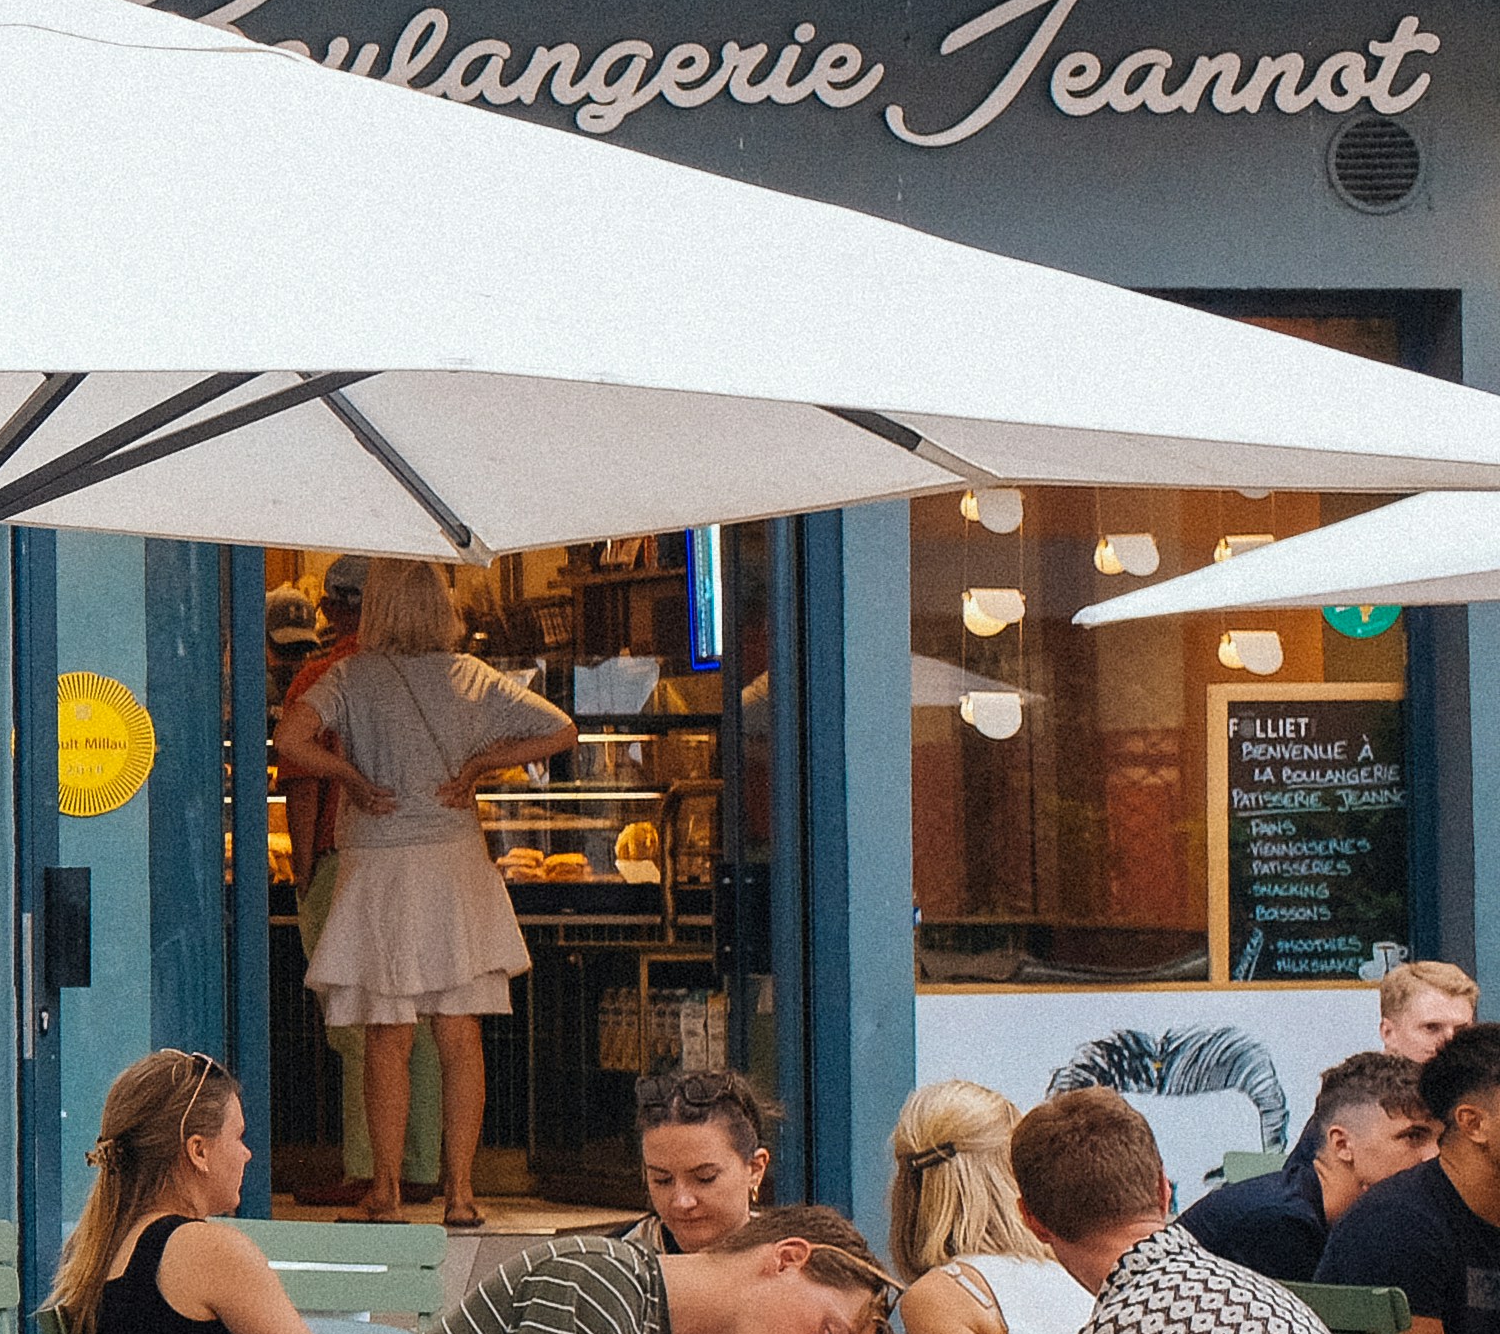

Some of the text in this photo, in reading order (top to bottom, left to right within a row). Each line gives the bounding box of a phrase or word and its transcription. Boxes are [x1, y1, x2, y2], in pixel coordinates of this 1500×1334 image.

[85, 737, 127, 750] Millau
[1241, 734, 1374, 762] BIENVENUE À
[1254, 763, 1400, 785] LA BOULANGERIE
